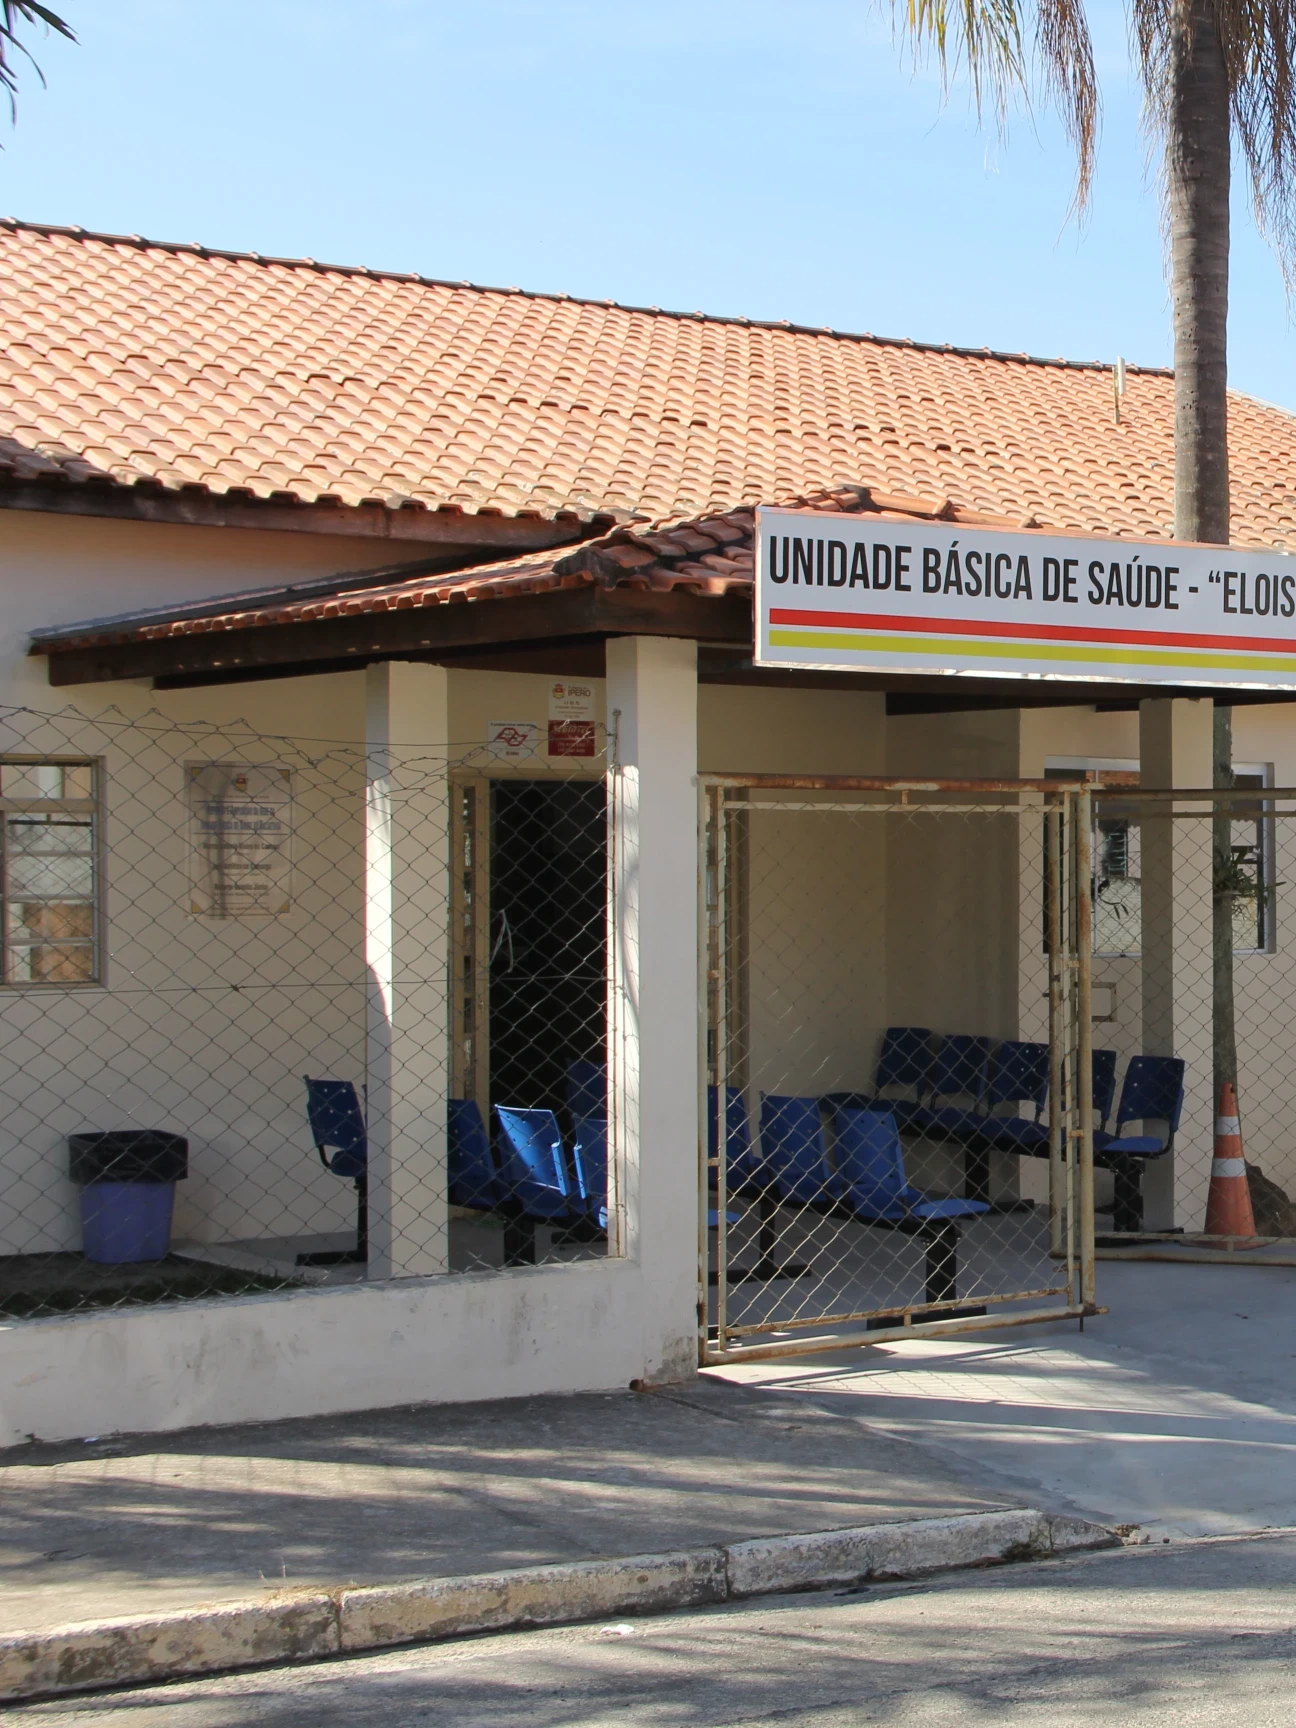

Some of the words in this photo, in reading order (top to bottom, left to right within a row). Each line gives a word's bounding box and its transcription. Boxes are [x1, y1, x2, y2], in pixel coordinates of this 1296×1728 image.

[769, 535, 912, 592] UNIDADE
[922, 540, 1033, 600] BÁSICA
[1042, 557, 1079, 603] DE
[1087, 555, 1180, 610] SAÚDE
